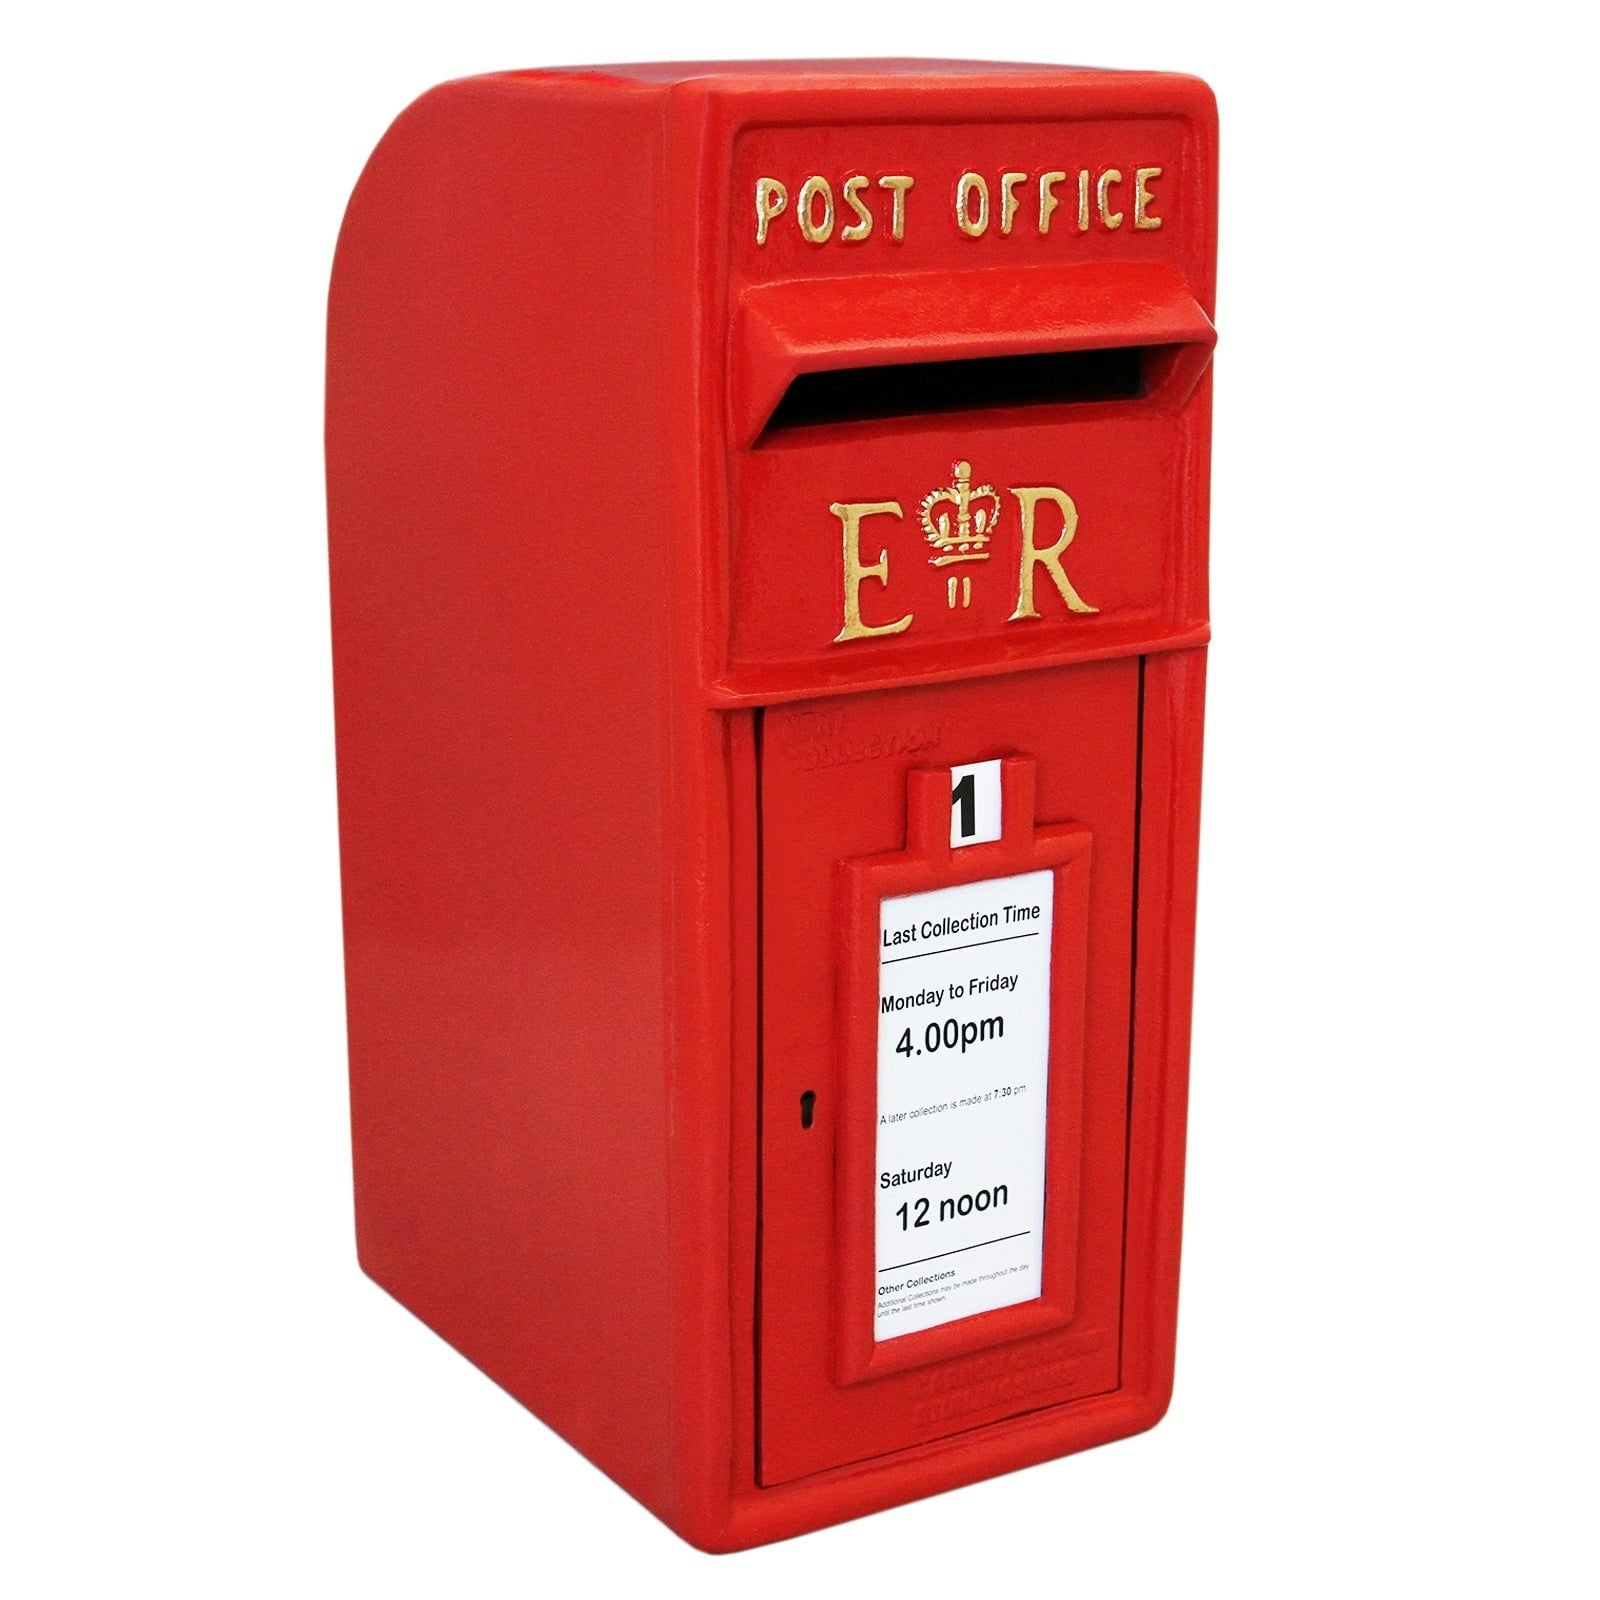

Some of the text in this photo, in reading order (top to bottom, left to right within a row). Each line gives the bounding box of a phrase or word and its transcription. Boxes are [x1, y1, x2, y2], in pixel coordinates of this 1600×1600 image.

[755, 168, 1162, 245] POST OFFICE
[829, 486, 1100, 643] E R
[951, 774, 976, 838] 1
[882, 904, 1041, 947] Last Collection Time
[881, 974, 1019, 1014] Monday to Friday
[895, 1015, 1005, 1058] 4.00pm
[880, 1084, 1027, 1125] A later collection is made at 7:30 pm
[880, 1161, 953, 1190] Saturday
[895, 1184, 1009, 1232] 12 noon
[878, 1269, 956, 1296] Other Collections
[907, 1288, 939, 1302] Collections
